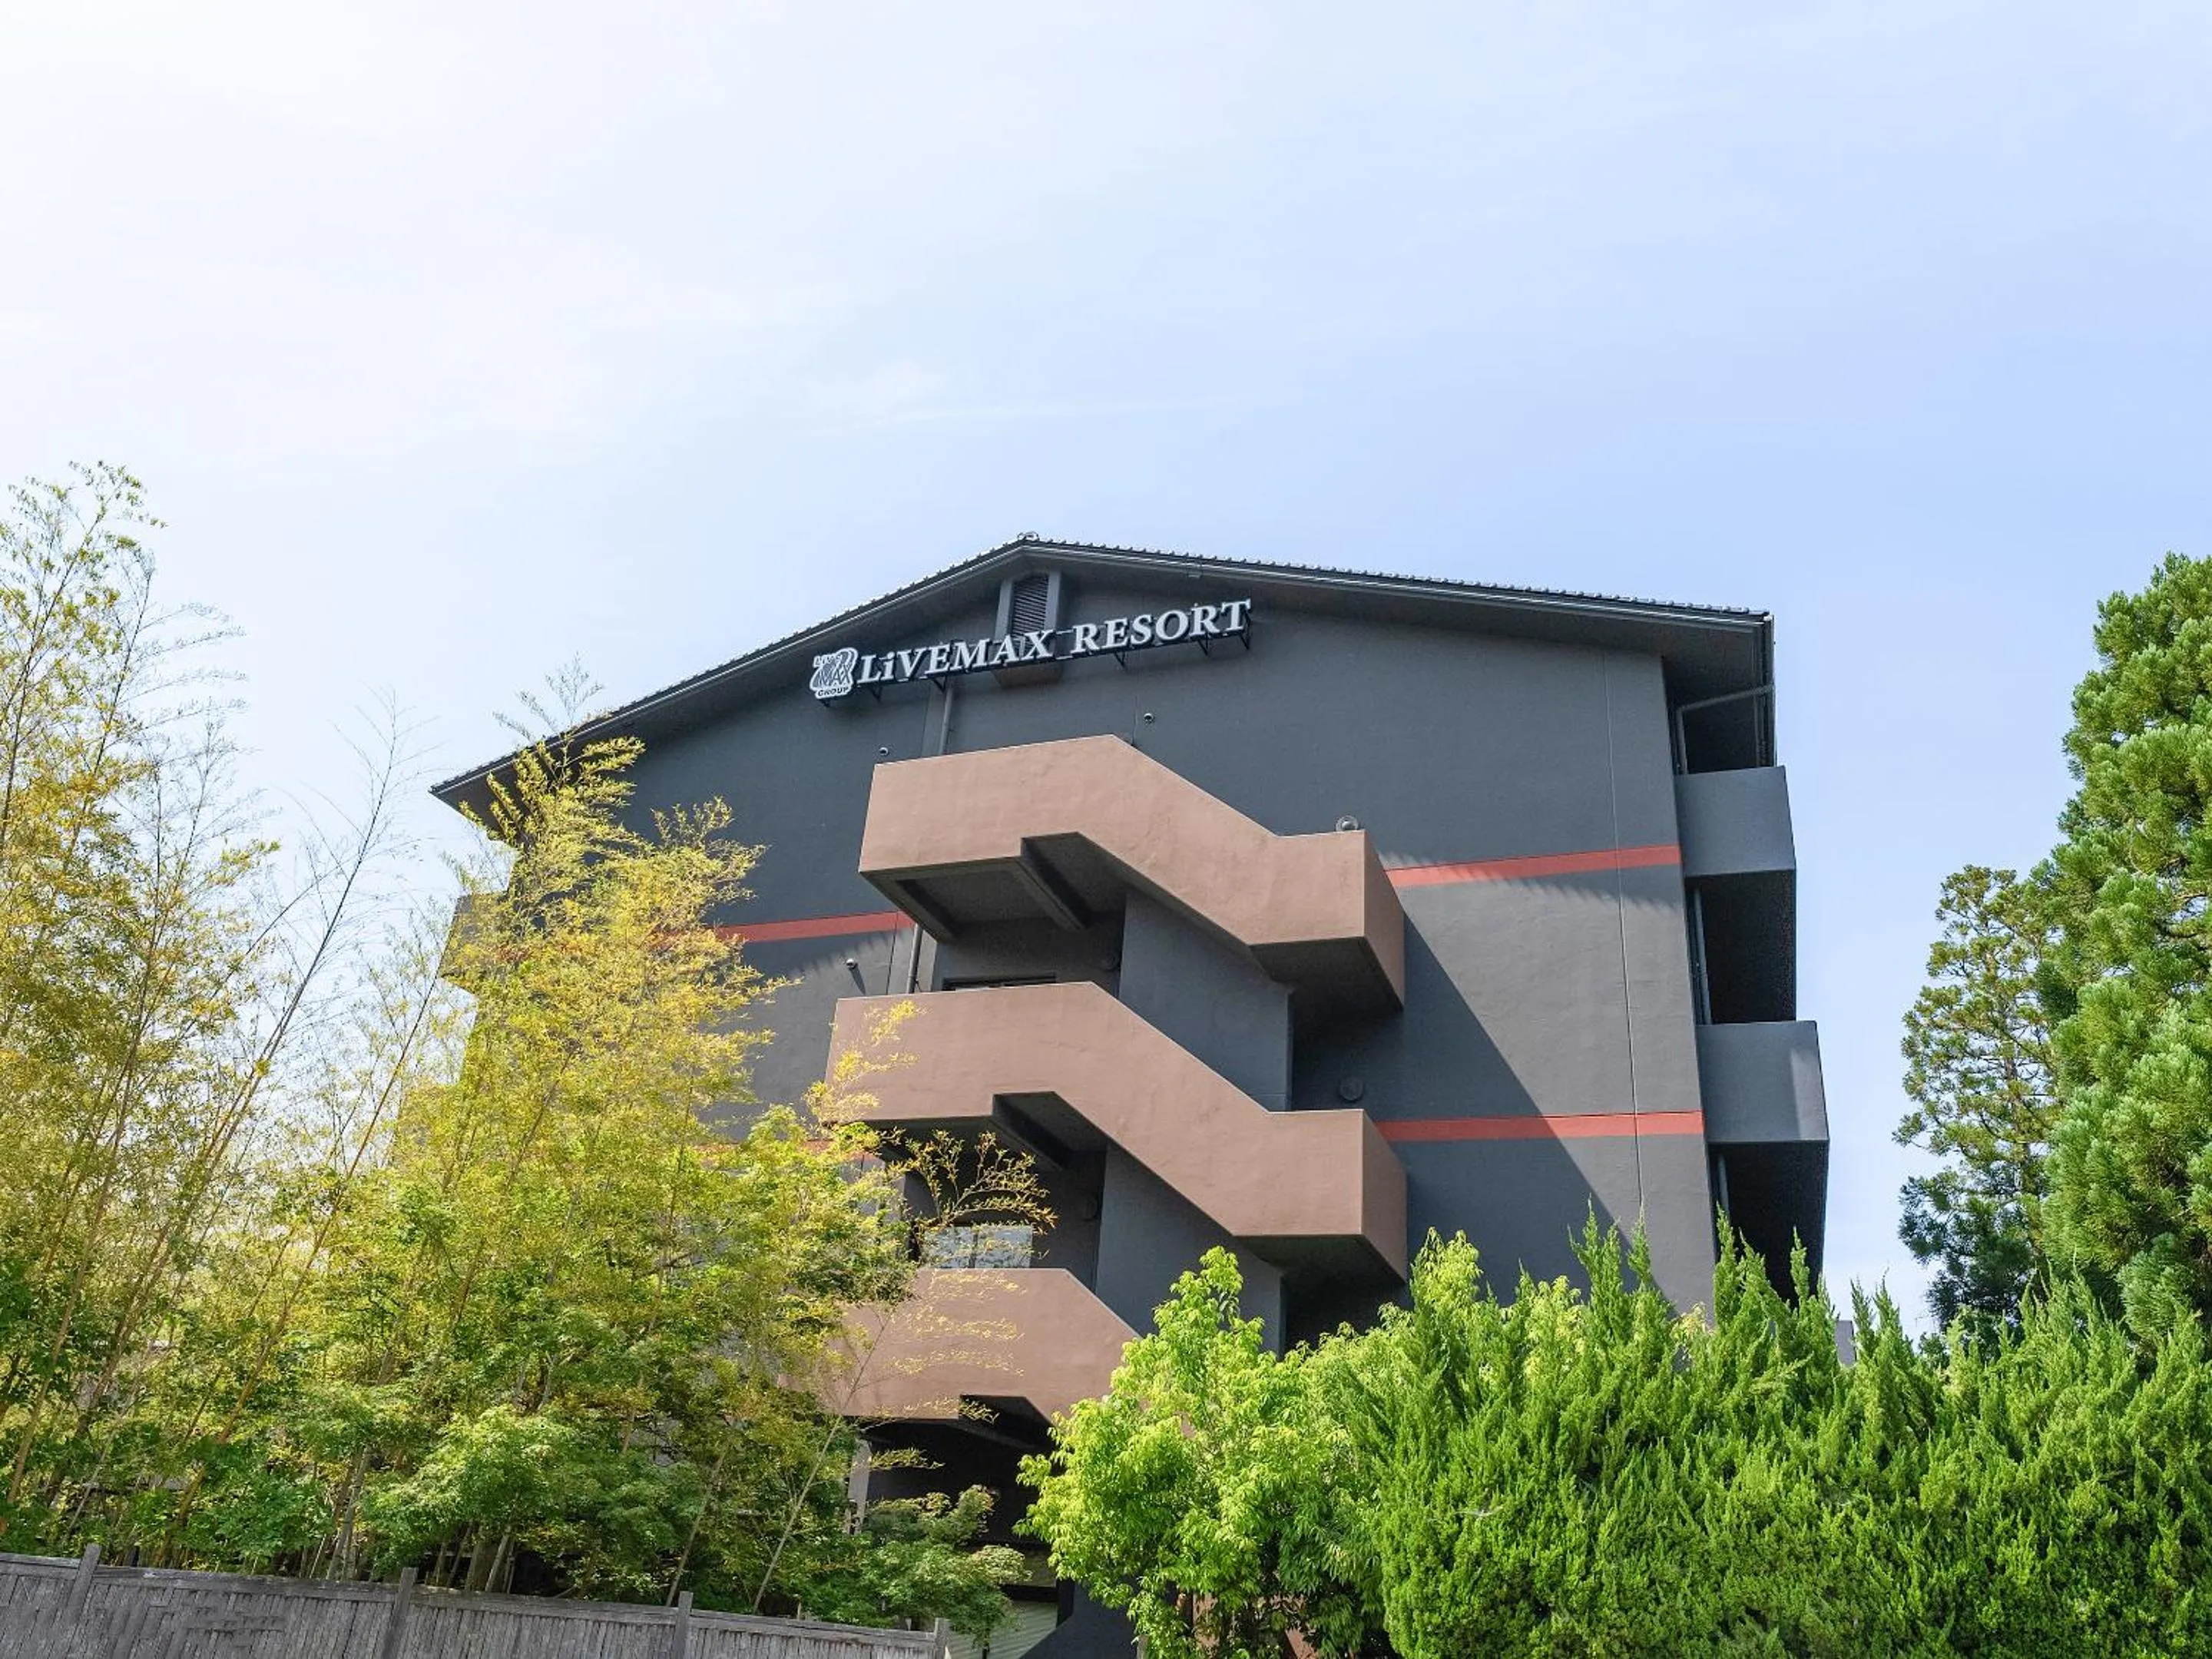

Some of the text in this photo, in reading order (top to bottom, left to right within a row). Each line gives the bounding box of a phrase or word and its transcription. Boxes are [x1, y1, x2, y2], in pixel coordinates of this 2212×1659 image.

[856, 598, 1252, 684] LiVEMAX RESORT
[817, 686, 849, 697] GROUP
